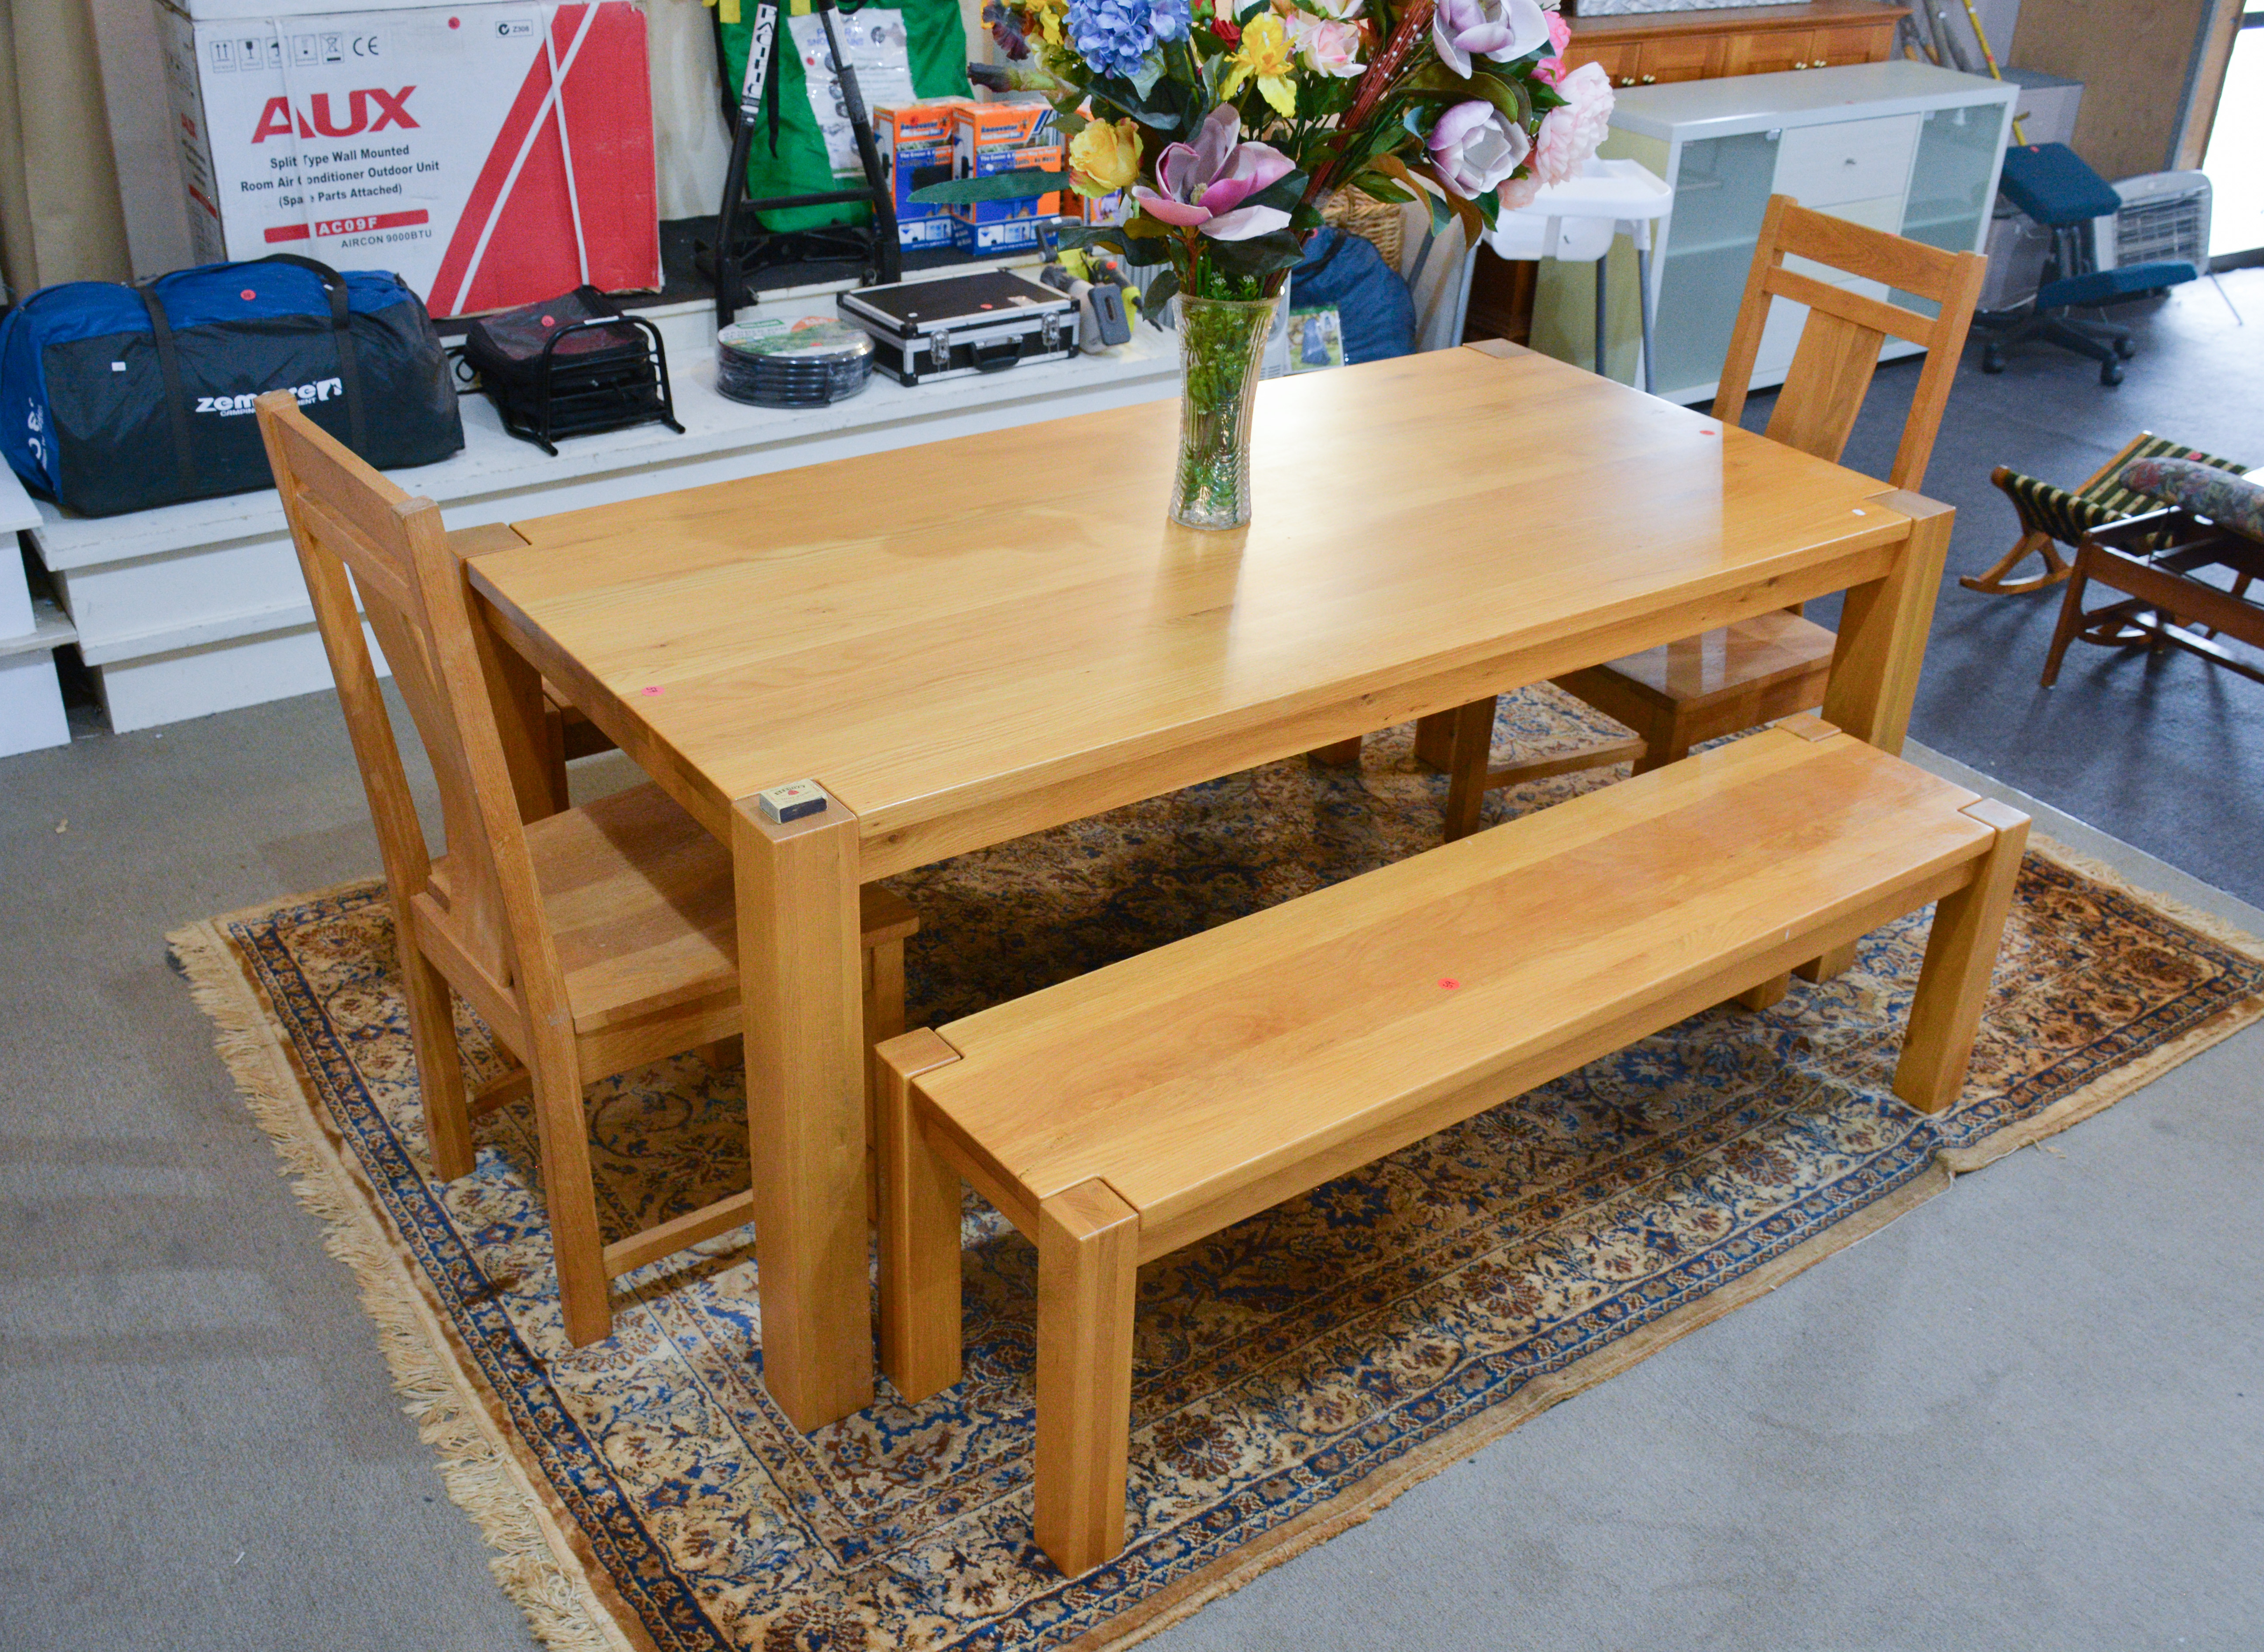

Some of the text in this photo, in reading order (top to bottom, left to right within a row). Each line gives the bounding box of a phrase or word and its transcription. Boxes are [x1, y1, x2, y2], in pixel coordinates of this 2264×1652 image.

[251, 86, 420, 143] AUX
[270, 156, 297, 169] Split
[332, 151, 357, 162] Wall
[361, 145, 409, 159] Mounted
[241, 179, 273, 192] Room
[278, 176, 293, 188] Air
[368, 164, 413, 178] Outdoor
[416, 160, 440, 172] Unit
[279, 183, 402, 209] (Spa Parts Attached)
[319, 217, 378, 235] AC09F
[341, 229, 432, 248] AIRCON 9000BTU
[220, 407, 256, 417] CAMPIN
